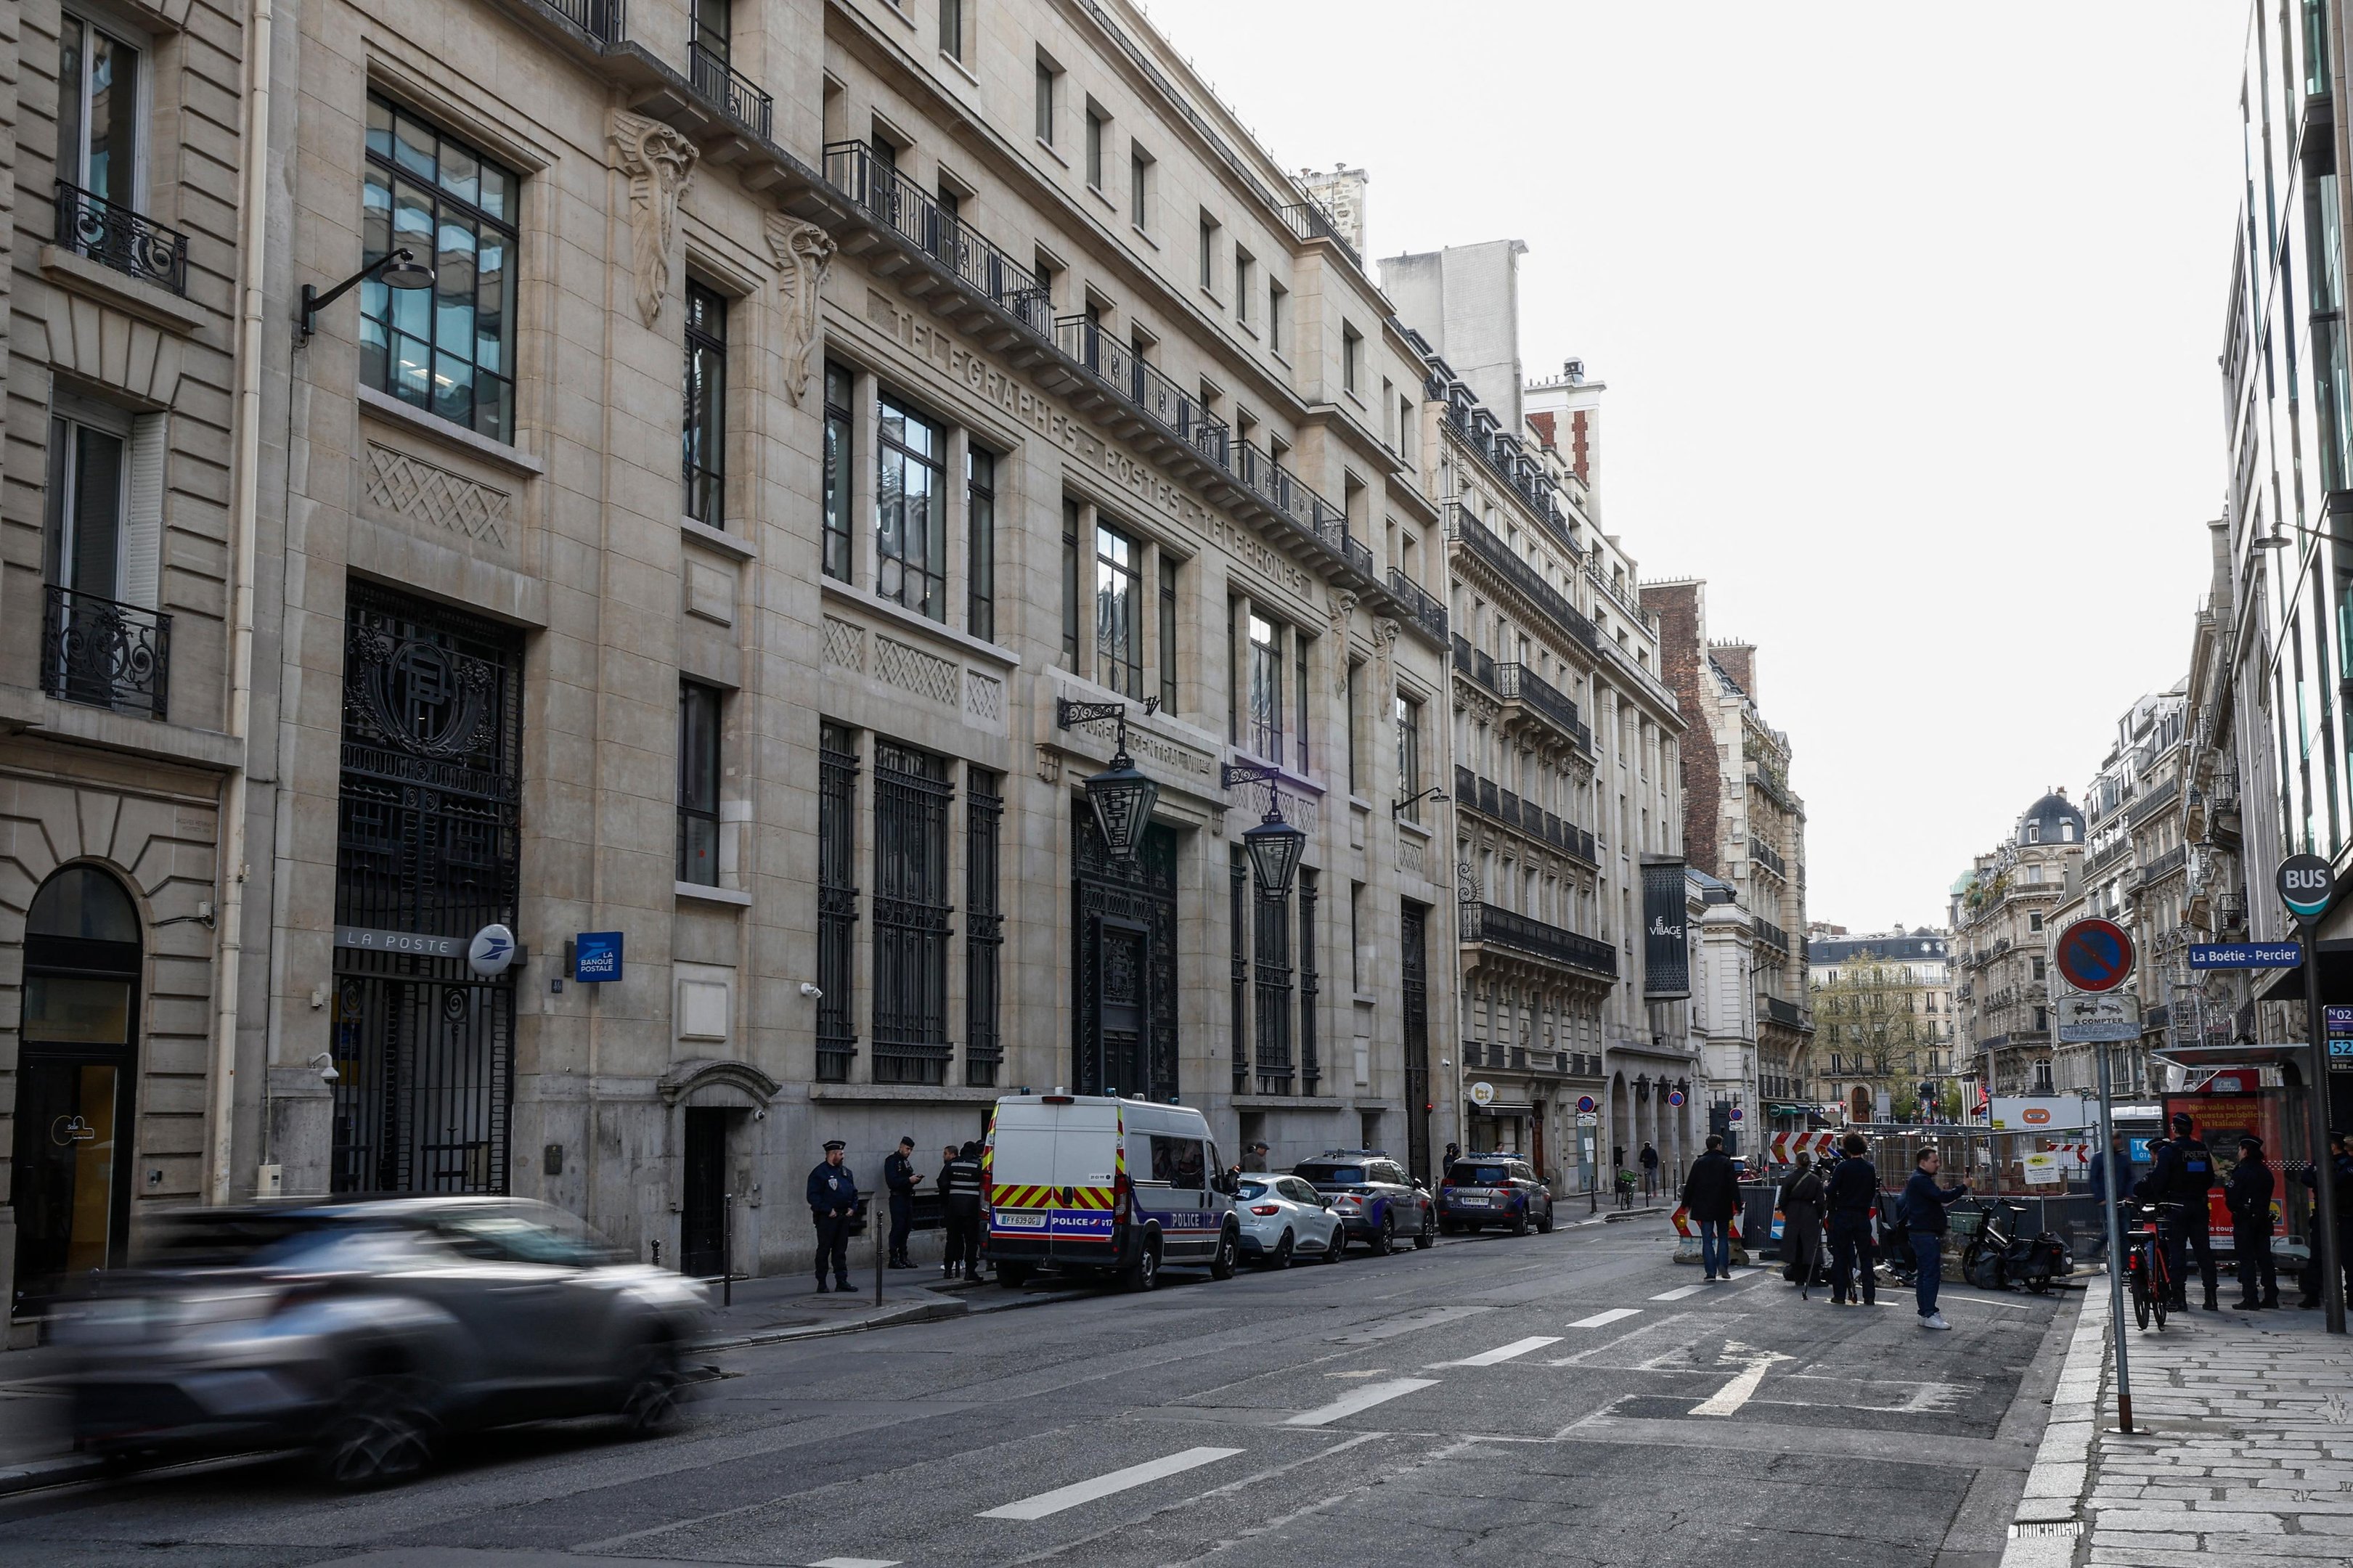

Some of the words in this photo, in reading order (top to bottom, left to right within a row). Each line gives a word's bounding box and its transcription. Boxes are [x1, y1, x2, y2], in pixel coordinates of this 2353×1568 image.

[1104, 445, 1180, 513] POSTES
[1079, 719, 1127, 745] BUREA
[1131, 733, 1179, 765] CENTRAL
[2286, 869, 2327, 889] BUS
[1655, 916, 1663, 927] LE
[1649, 924, 1681, 935] VILLAGE
[347, 933, 372, 945] LA
[386, 936, 449, 953] POSTE
[2192, 951, 2206, 963] La
[2209, 950, 2246, 962] Boétie
[2255, 949, 2296, 960] Percier
[2333, 1041, 2353, 1054] 52
[1052, 1217, 1089, 1226] POLICE
[1172, 1213, 1199, 1228] POLICE
